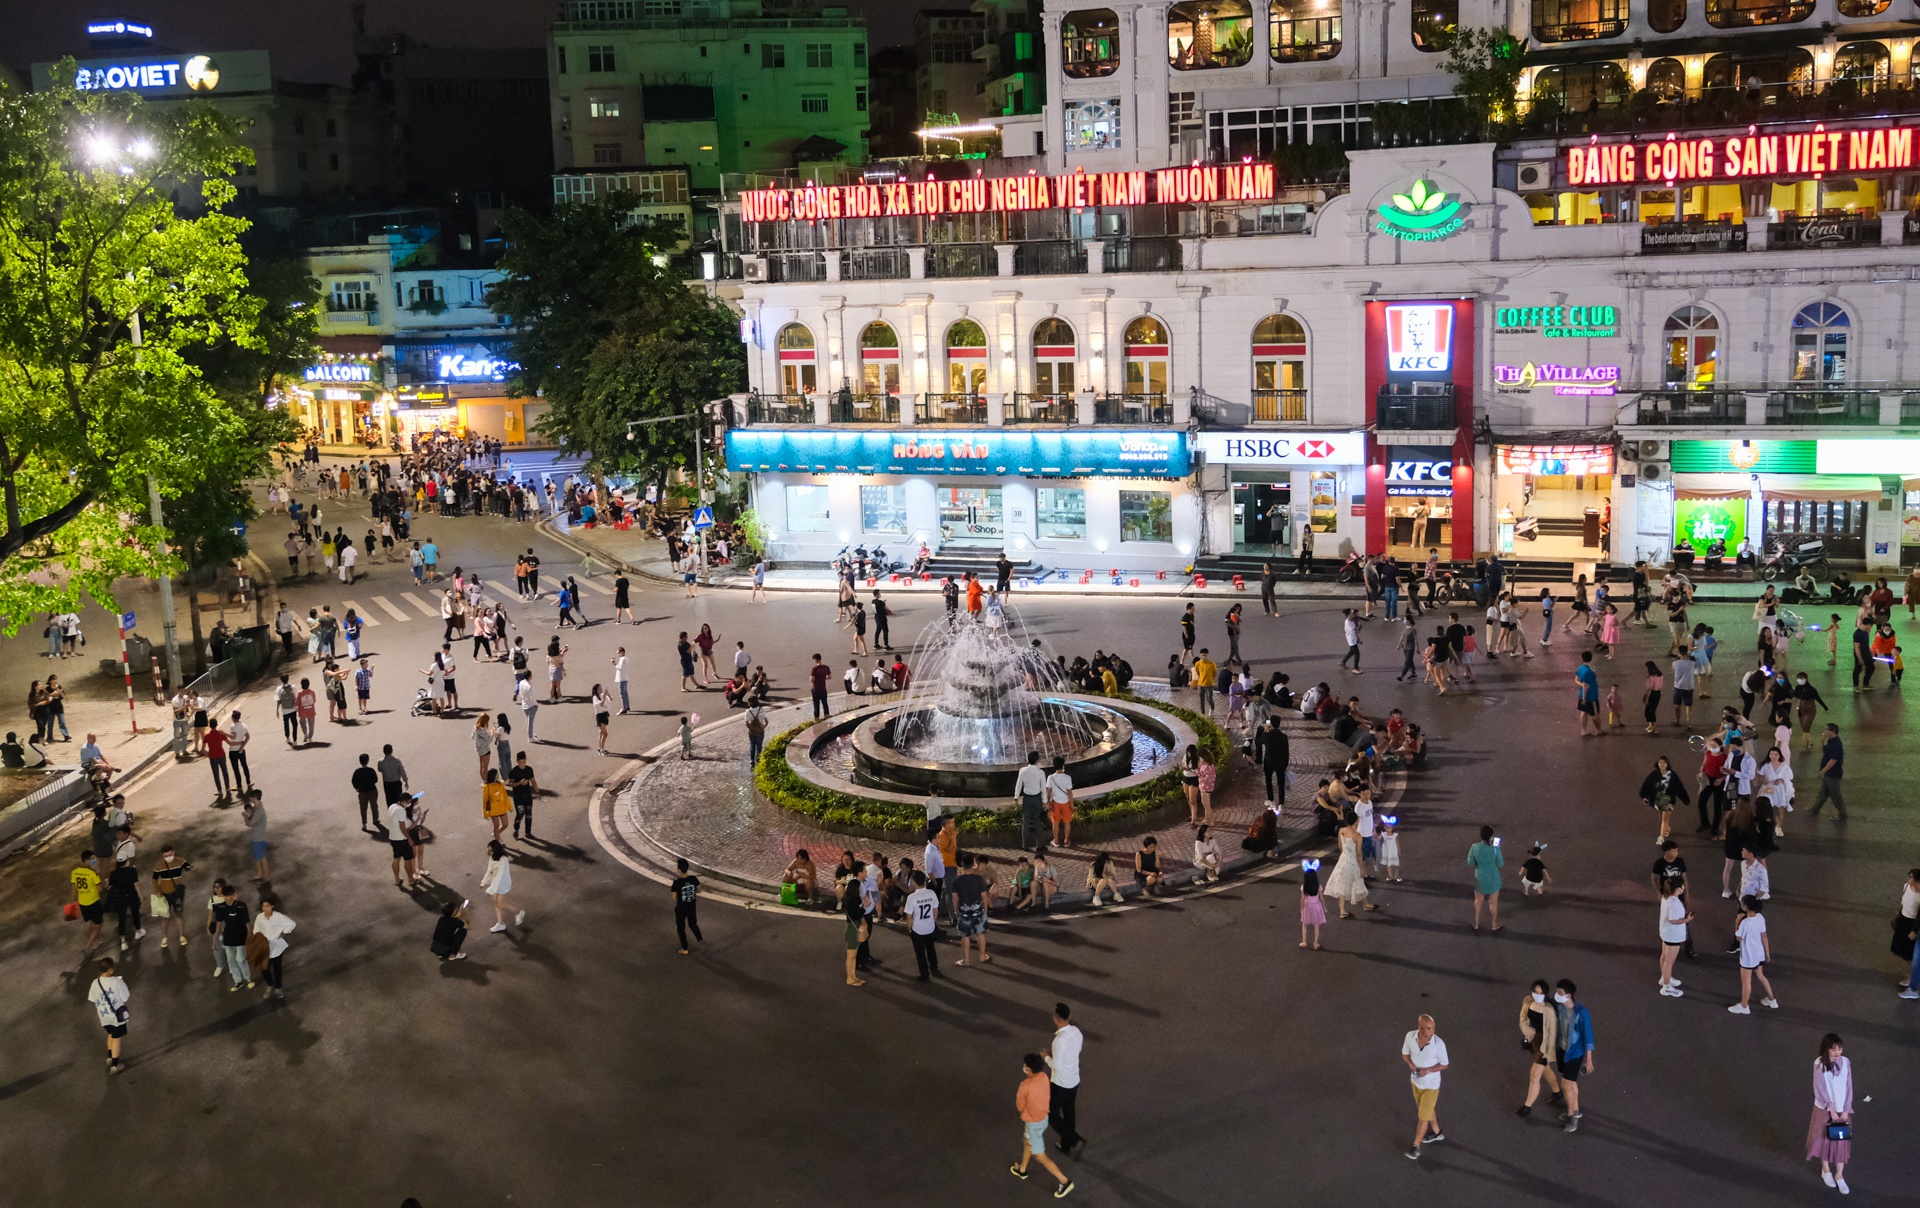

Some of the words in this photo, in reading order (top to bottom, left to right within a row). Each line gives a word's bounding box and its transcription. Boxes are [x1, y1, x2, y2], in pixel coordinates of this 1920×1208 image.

[1568, 134, 1635, 186] ĐẢNG
[1645, 132, 1714, 187] CỘNG
[1724, 124, 1778, 177] SẢN
[1785, 123, 1842, 179] VIỆT
[1848, 128, 1912, 170] NAM
[741, 181, 790, 222] NƯỚC
[793, 180, 840, 226] CỘNG
[845, 177, 882, 218] HÒA
[885, 176, 911, 216] XÃ
[914, 173, 944, 221] HỘI
[949, 169, 986, 213] CHỦ
[991, 169, 1050, 212] NGHĨA
[1055, 165, 1097, 214] VIỆT
[1101, 171, 1146, 206] NAM
[1157, 159, 1218, 204] MUÔN
[1225, 155, 1275, 200] NĂM
[1376, 218, 1463, 241] PHYTOPHARCO
[1497, 306, 1563, 327] COFFEE
[1570, 305, 1615, 326] CLUB
[1543, 327, 1560, 337] Café
[1562, 328, 1570, 337] &
[1571, 327, 1614, 337] Restaurant
[1399, 356, 1439, 369] KFC
[306, 365, 371, 380] BALCONY
[1555, 386, 1614, 395] Restaurants
[894, 438, 945, 459] HỒNG
[951, 443, 988, 459] VÂN
[1225, 439, 1290, 458] HSBC
[1387, 461, 1452, 481] KFC
[1417, 488, 1452, 496] Kentucky
[76, 877, 88, 889] 86
[919, 903, 931, 920] 12
